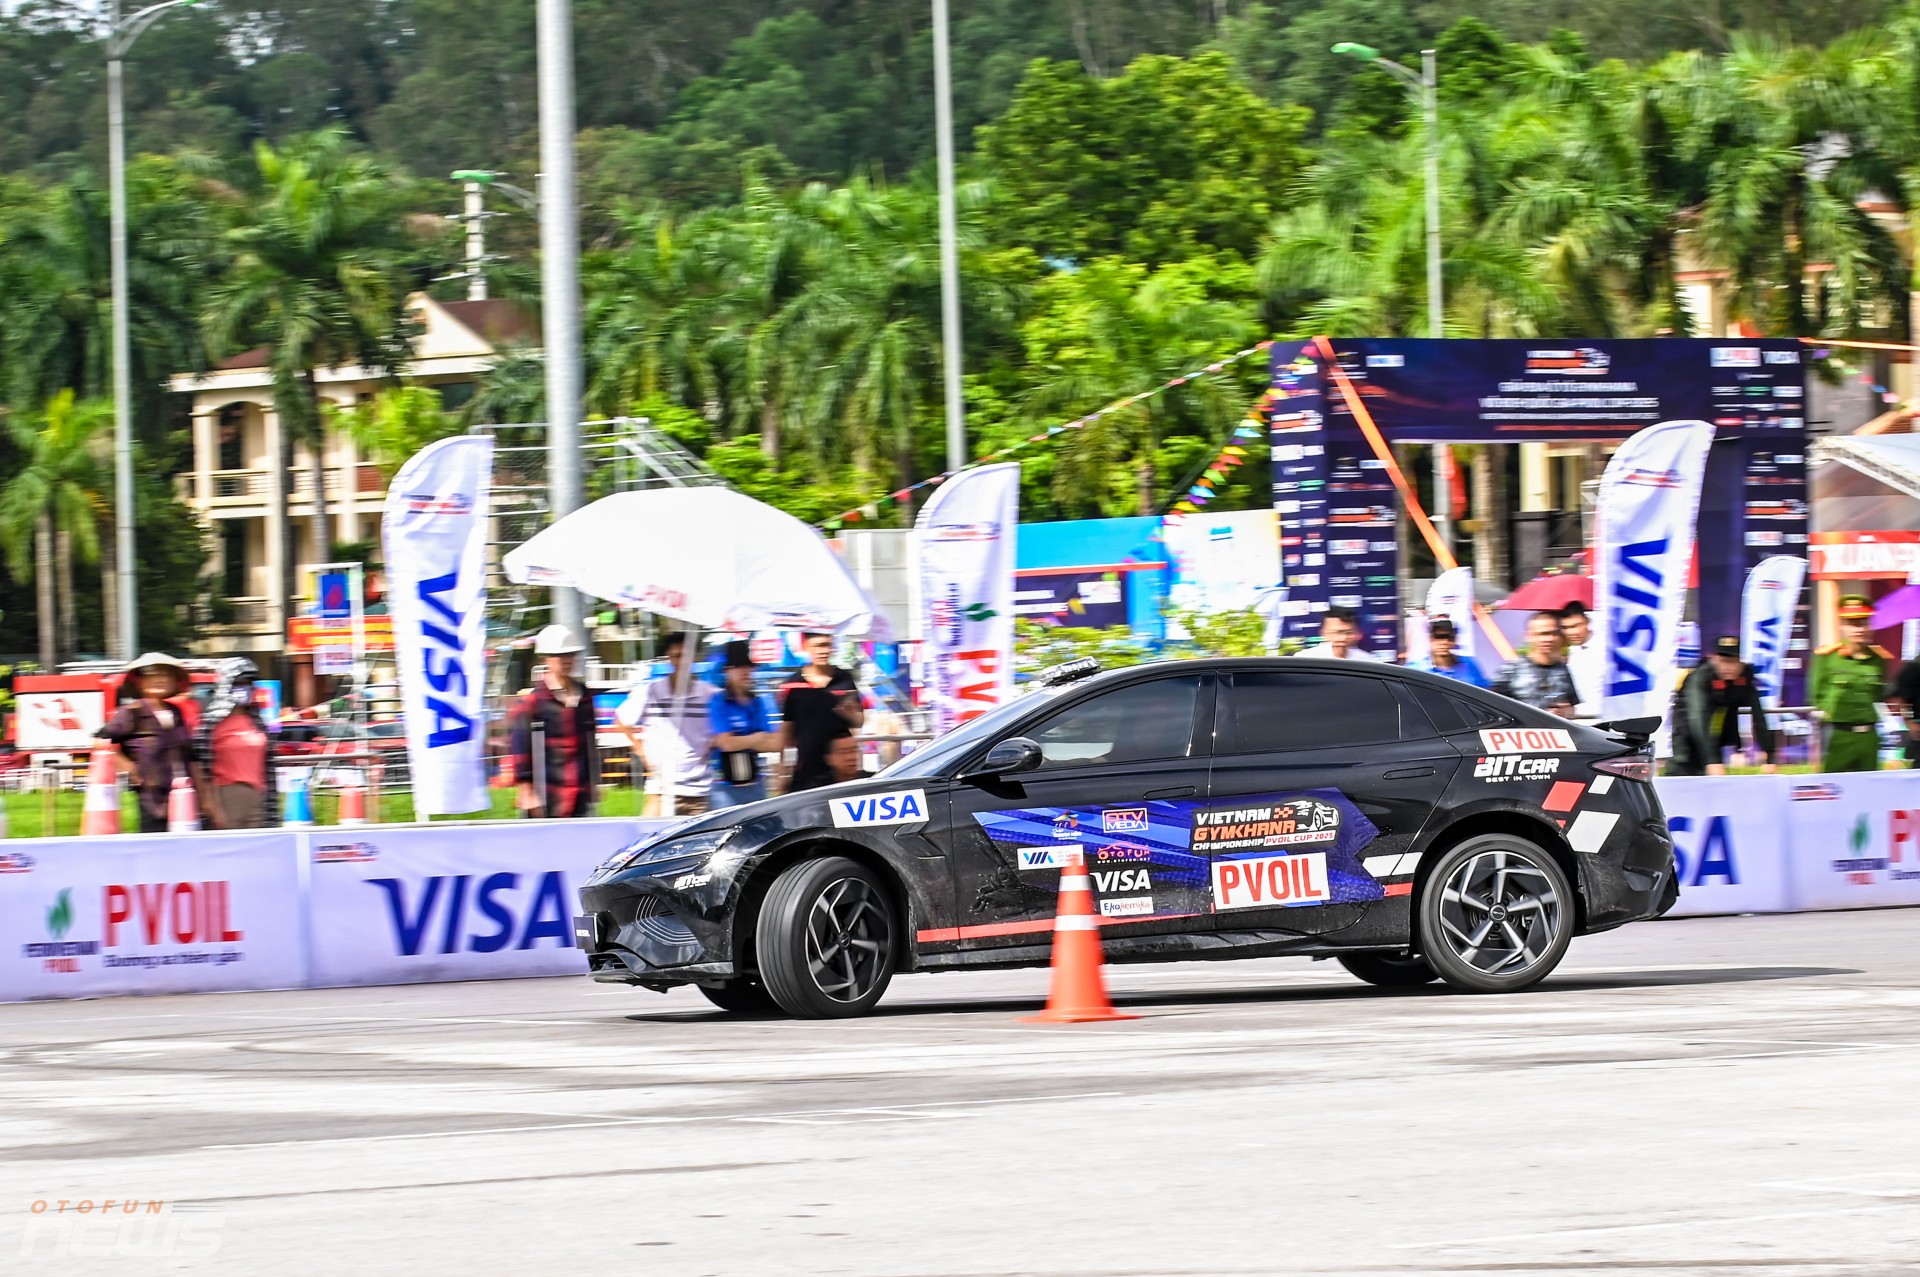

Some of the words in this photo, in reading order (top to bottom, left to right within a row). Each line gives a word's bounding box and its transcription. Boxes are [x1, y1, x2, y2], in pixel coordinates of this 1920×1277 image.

[1603, 537, 1670, 697] VISA
[417, 572, 473, 749] VISA
[1488, 731, 1567, 750] PVOIL
[1485, 775, 1510, 783] BEST
[841, 795, 920, 821] VISA
[1196, 808, 1271, 825] VIETNAM
[1106, 820, 1147, 831] MEDIA
[1193, 820, 1297, 841] GYMKHANA
[1192, 838, 1264, 851] CHAMPIONSHIP
[1266, 836, 1291, 845] PVOIL
[1294, 834, 1313, 842] CUP
[1315, 832, 1334, 840] 2025
[1089, 869, 1152, 892] VISA
[1219, 857, 1322, 905] PVOIL
[101, 880, 247, 948] PVOIL
[361, 870, 575, 957] VISA
